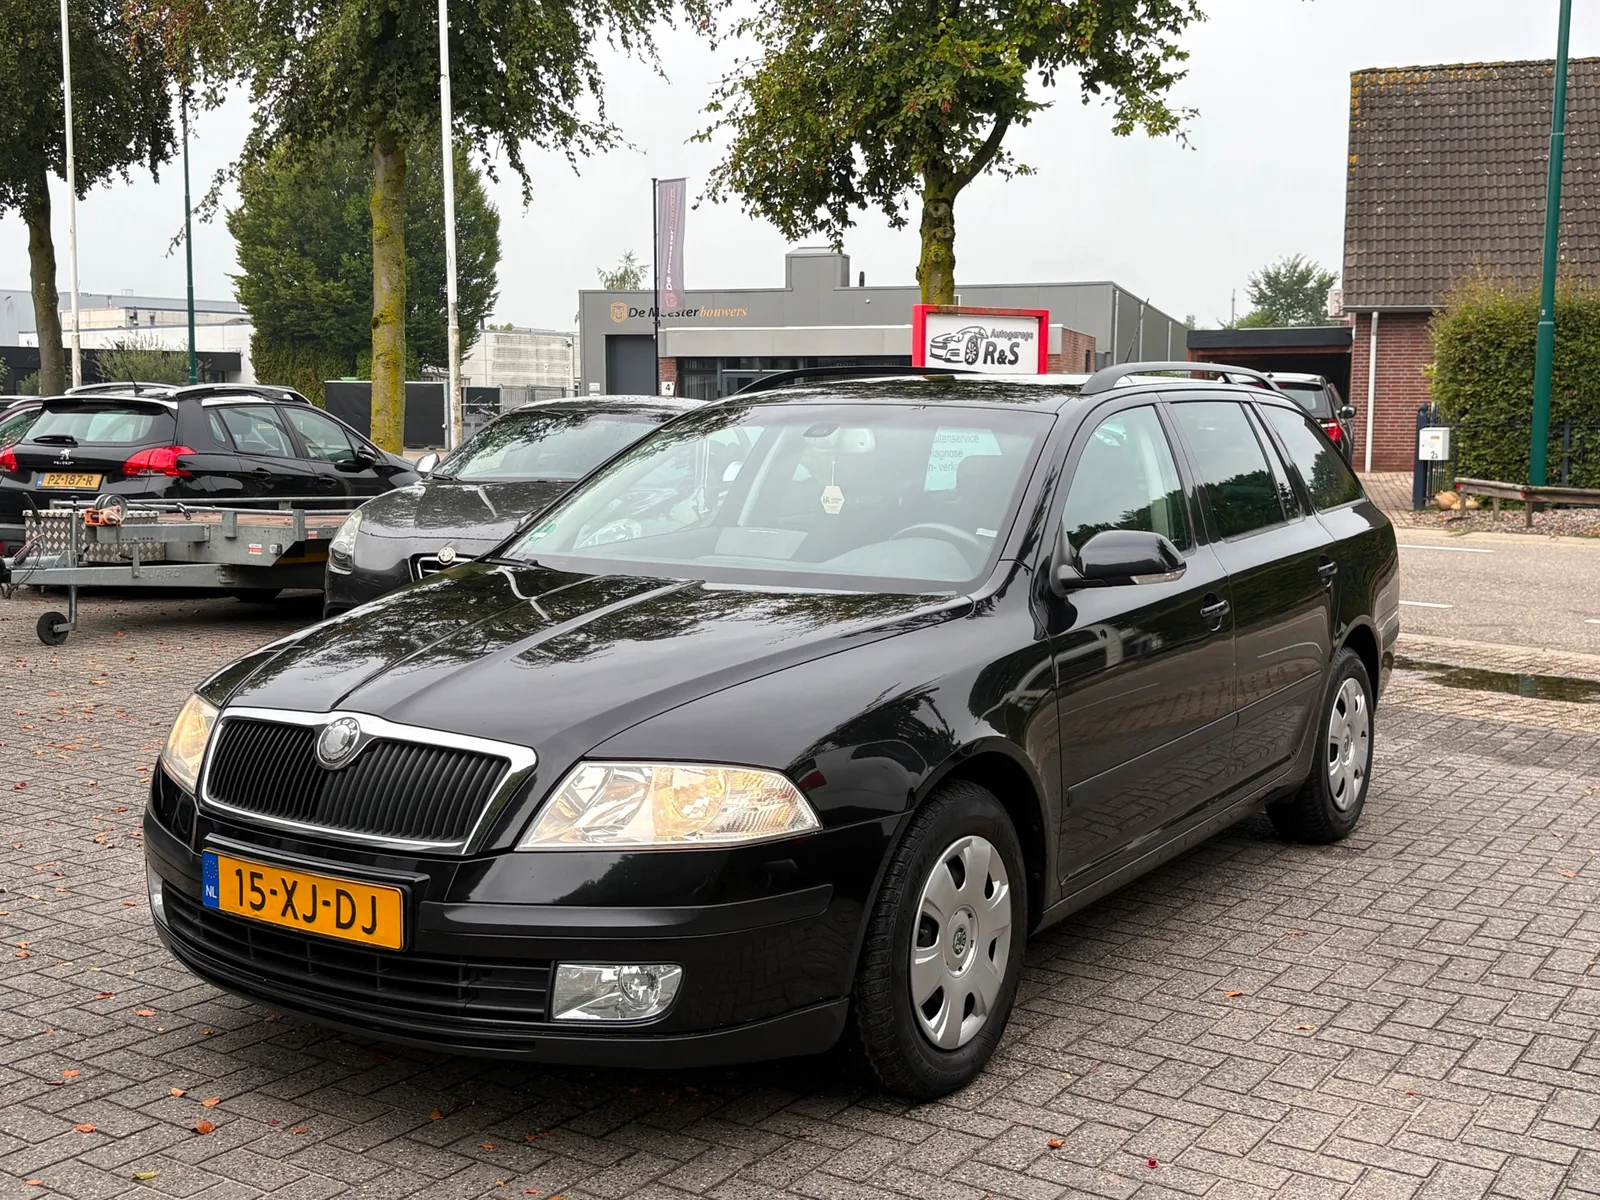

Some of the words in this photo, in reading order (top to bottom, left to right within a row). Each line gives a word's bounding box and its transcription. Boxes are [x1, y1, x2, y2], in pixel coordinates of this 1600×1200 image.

[628, 307, 646, 318] De
[990, 328, 1034, 342] Autogarage
[983, 341, 1020, 365] R&S
[665, 383, 671, 392] 4
[47, 474, 94, 486] PZ-187-R
[138, 568, 182, 579] DUARD
[205, 885, 218, 899] NL
[235, 868, 378, 935] 15-XJ-DJ
